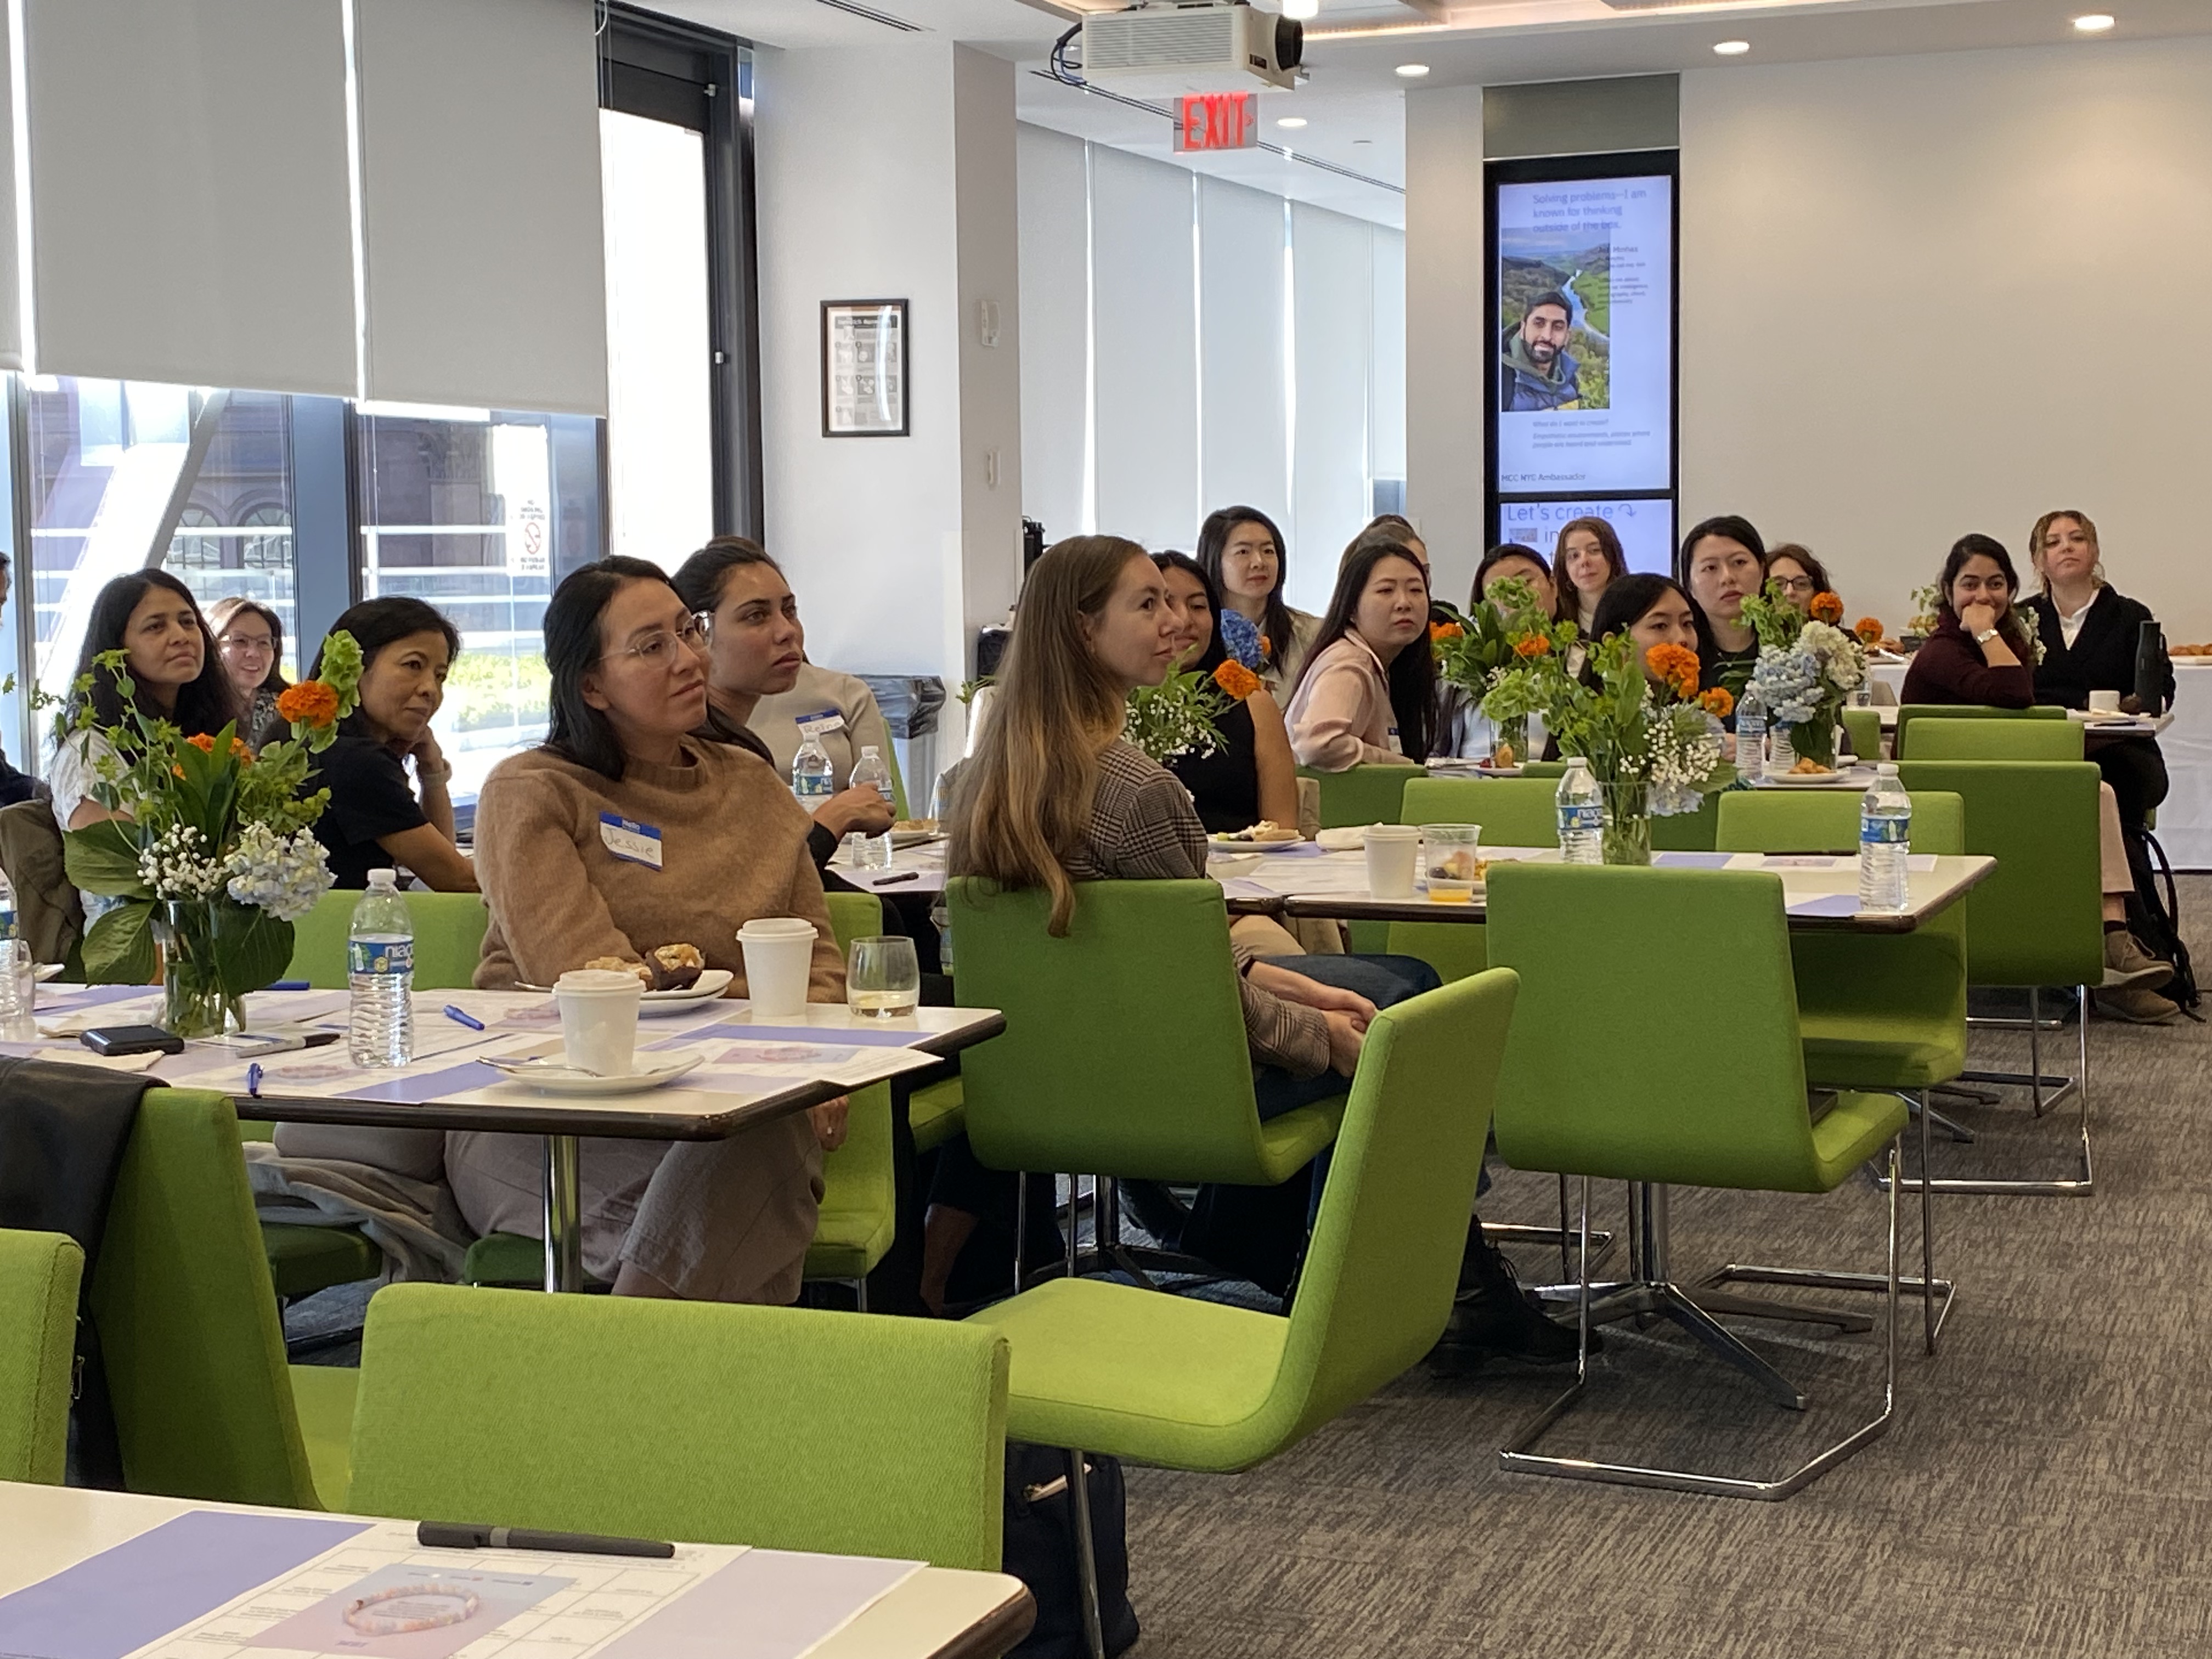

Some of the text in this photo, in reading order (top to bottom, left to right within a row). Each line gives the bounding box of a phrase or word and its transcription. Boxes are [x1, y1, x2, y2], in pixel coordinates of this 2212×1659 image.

[1183, 92, 1248, 149] EXIT
[1532, 194, 1567, 204] Solving
[1533, 206, 1622, 217] known for thinking
[1533, 223, 1568, 233] outside
[1571, 222, 1580, 230] of
[1583, 222, 1599, 230] the
[1508, 503, 1613, 521] Let's create
[605, 827, 654, 858] Jessie
